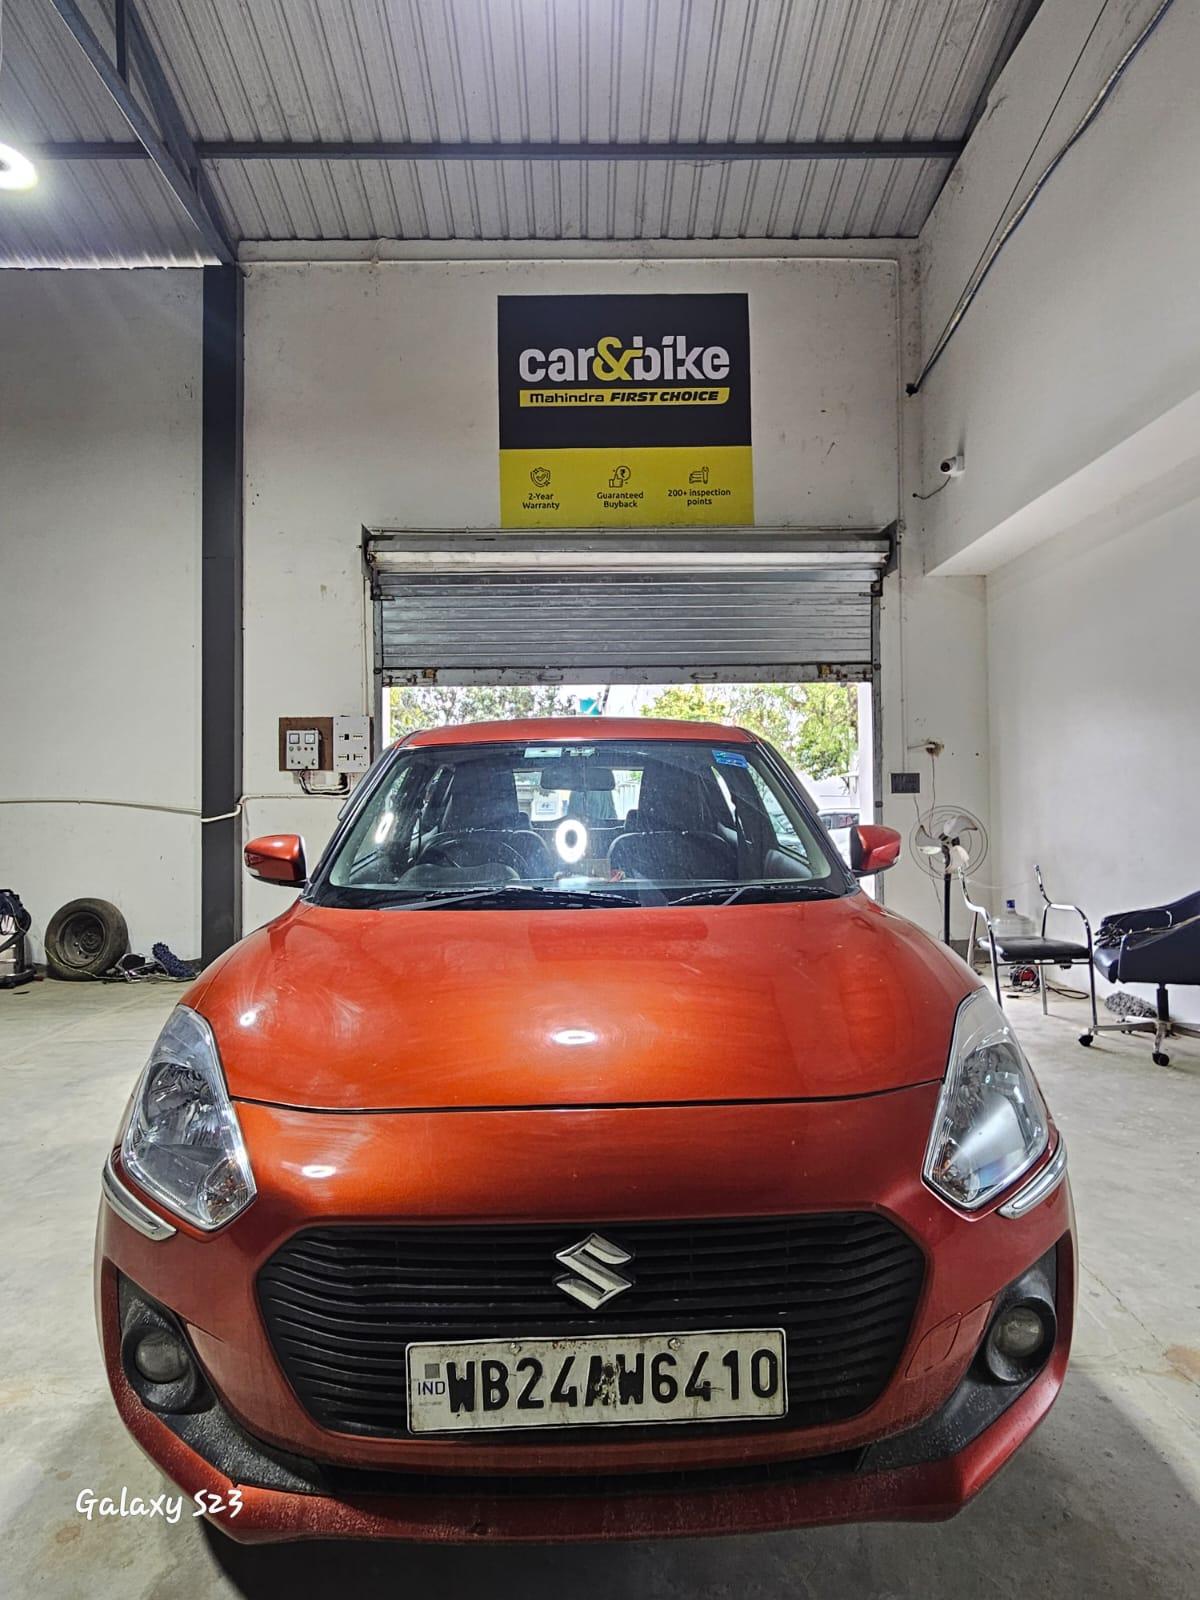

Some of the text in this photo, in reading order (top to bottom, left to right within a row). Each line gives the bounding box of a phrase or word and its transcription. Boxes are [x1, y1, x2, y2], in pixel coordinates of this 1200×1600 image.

[518, 335, 730, 382] car&bike
[529, 391, 719, 404] Mahindra FIRST CHOICE
[528, 493, 554, 501] 2-Year
[596, 492, 644, 500] Guaranteed
[667, 489, 687, 497] 200+
[522, 501, 560, 511] Warranty
[603, 501, 638, 510] Buyback
[687, 498, 712, 506] points
[418, 1381, 445, 1395] IND
